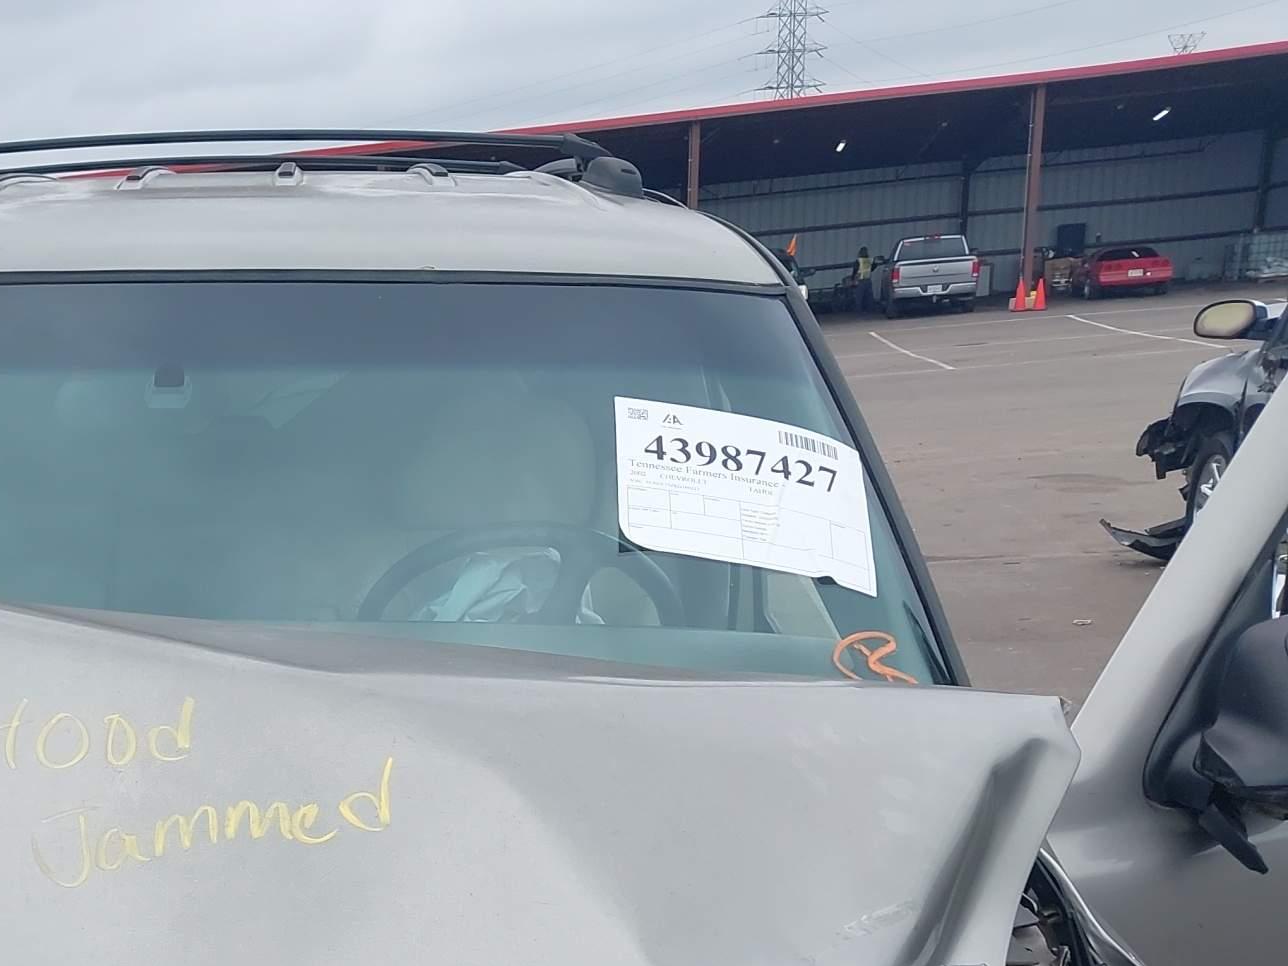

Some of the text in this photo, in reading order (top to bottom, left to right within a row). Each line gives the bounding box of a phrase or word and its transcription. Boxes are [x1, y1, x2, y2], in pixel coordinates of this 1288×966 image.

[629, 458, 779, 488] Tennessee Farmers Insurance
[644, 435, 837, 492] 43987427
[32, 757, 394, 888] Jammed
